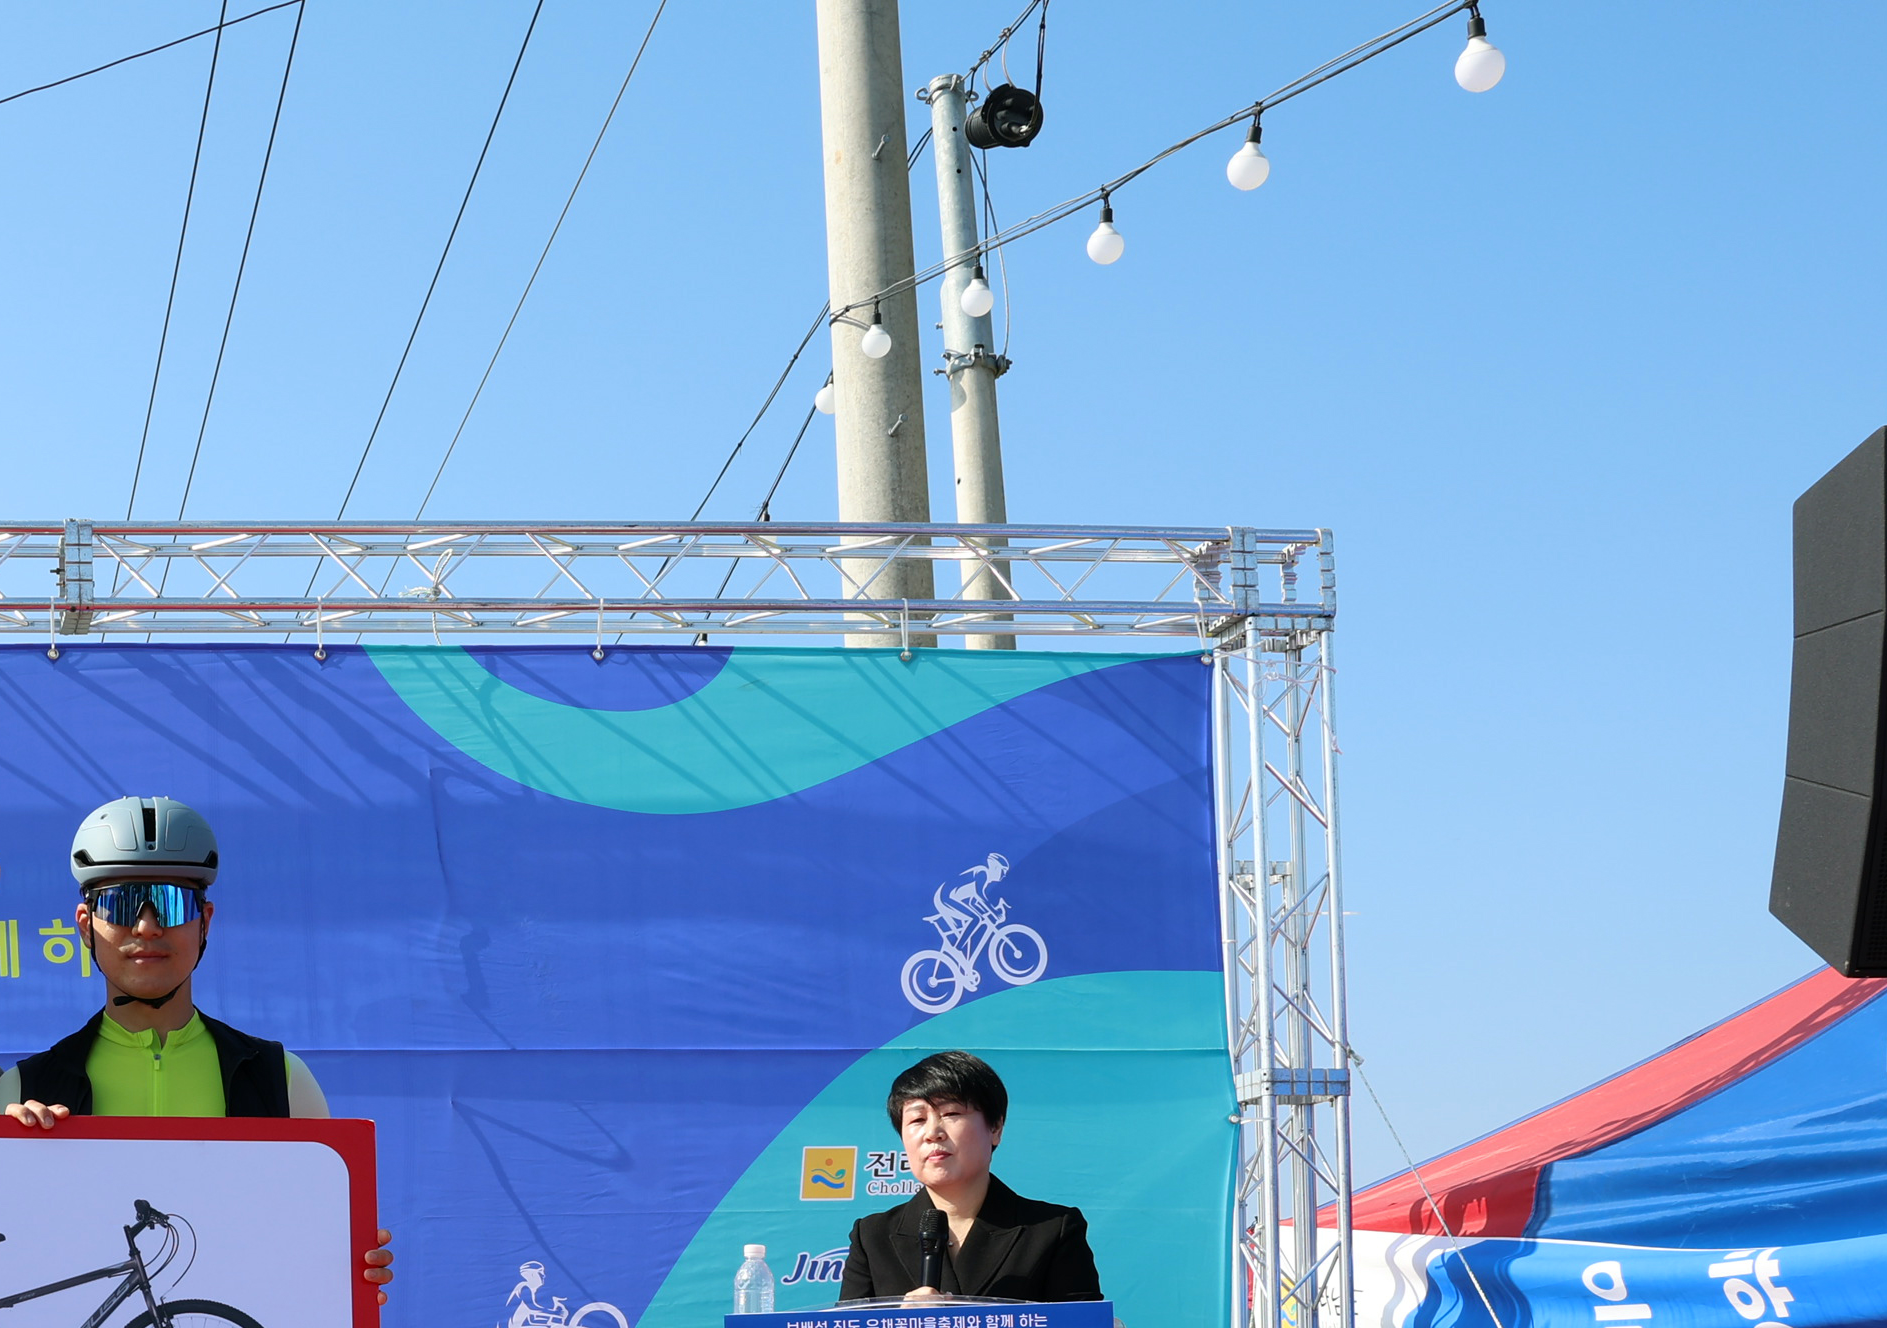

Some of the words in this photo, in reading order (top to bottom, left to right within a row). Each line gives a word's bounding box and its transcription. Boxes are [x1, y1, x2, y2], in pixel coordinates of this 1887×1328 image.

[38, 918, 91, 978] 하
[867, 1181, 924, 1194] Cholla
[782, 1253, 843, 1284] Jin
[985, 1314, 1014, 1328] 함께
[1019, 1313, 1048, 1328] 하는
